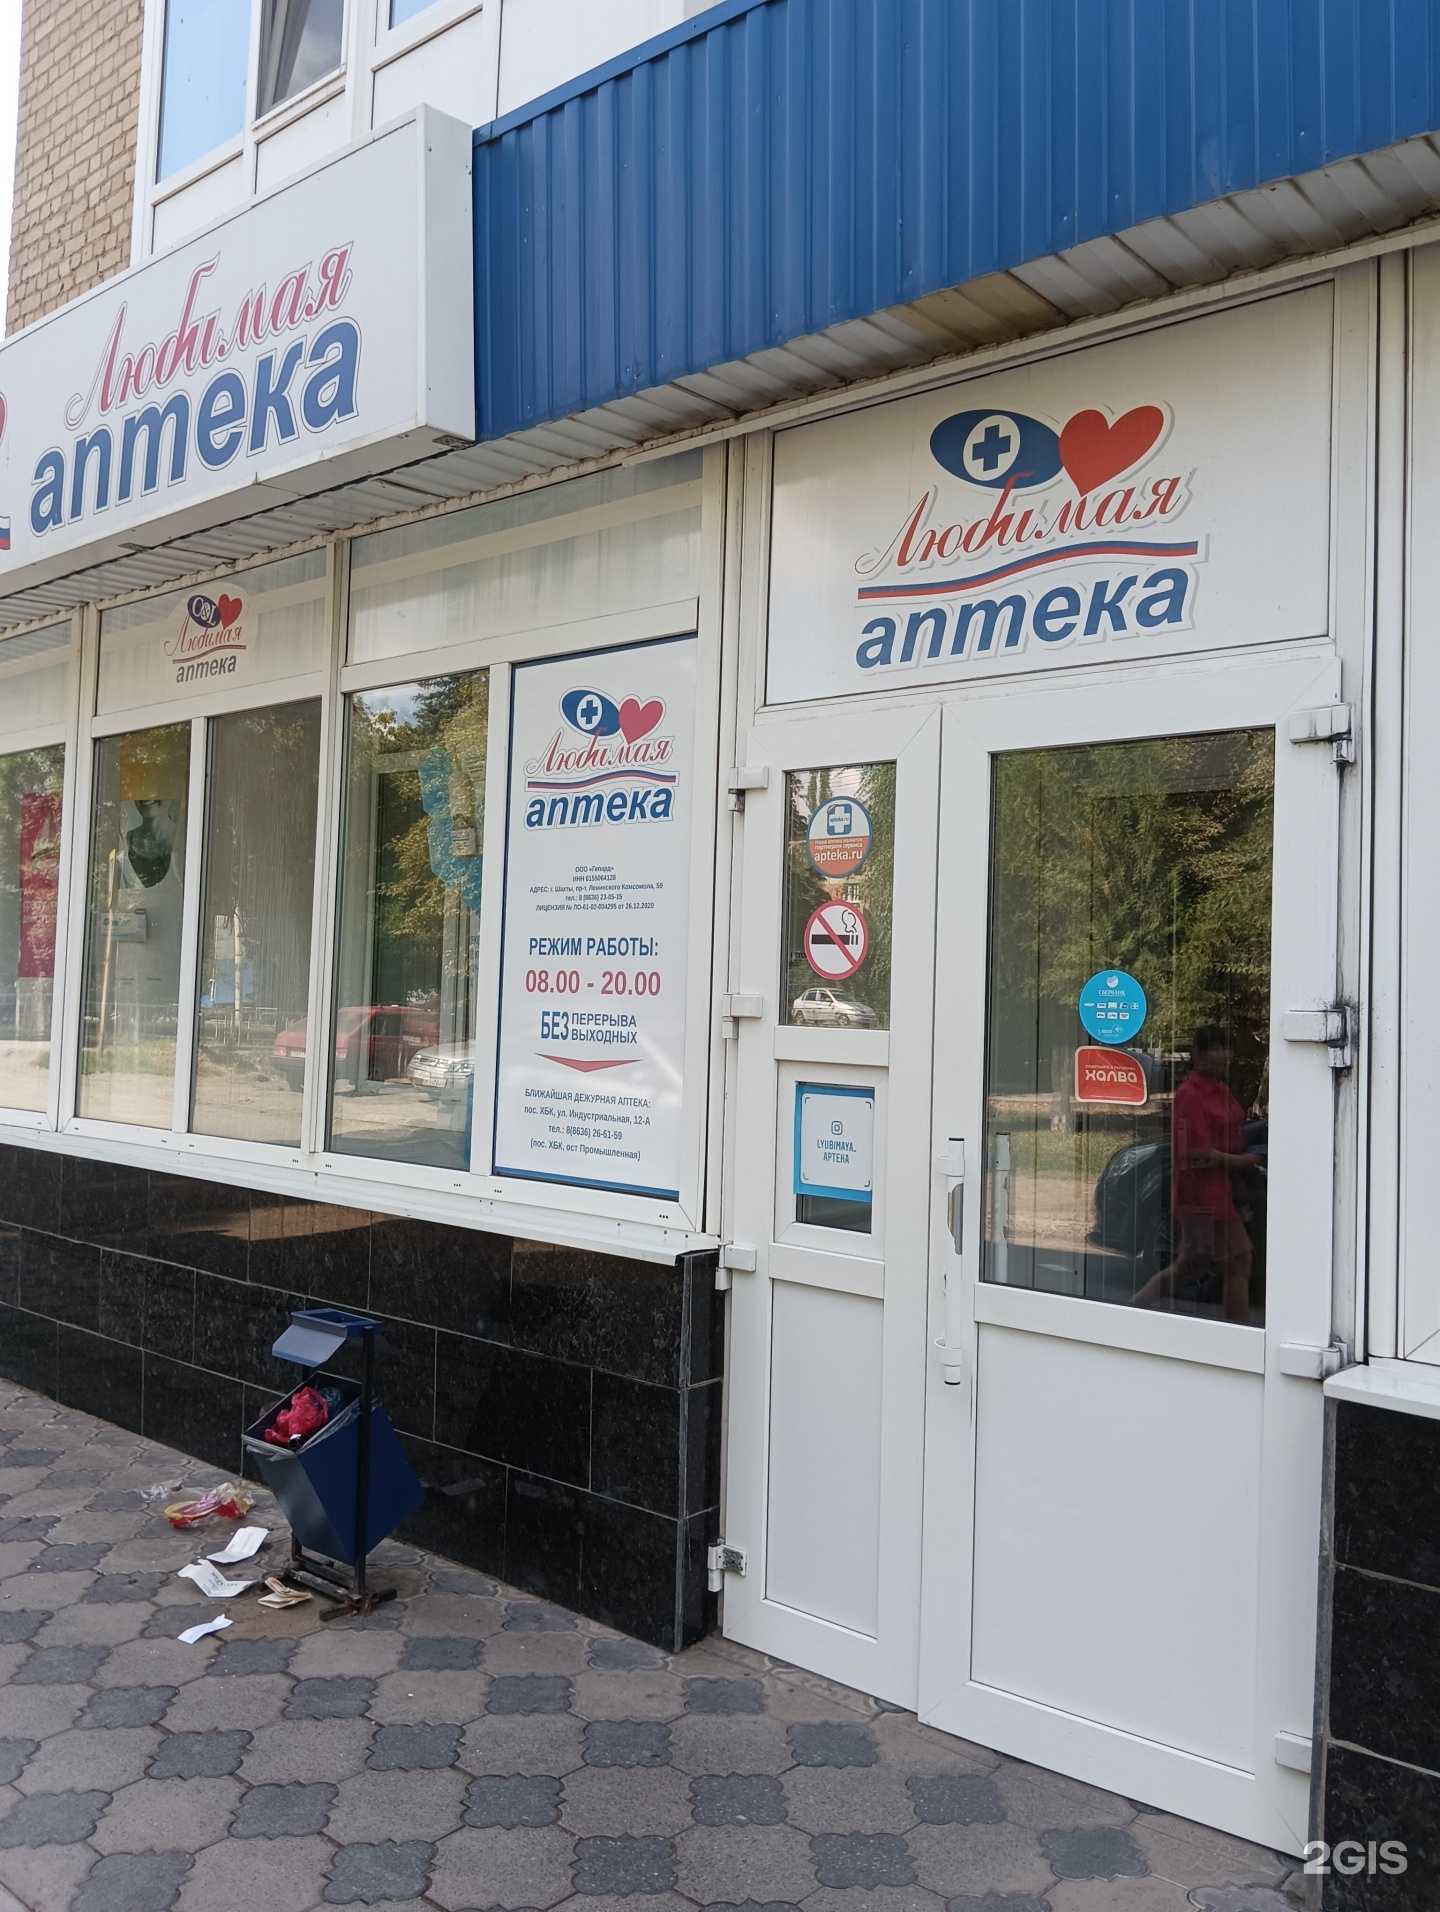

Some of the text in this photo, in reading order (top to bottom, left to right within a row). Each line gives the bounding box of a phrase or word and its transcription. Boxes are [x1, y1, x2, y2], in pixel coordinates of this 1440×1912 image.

[68, 246, 351, 425] Любимая
[31, 321, 357, 534] аптека
[854, 471, 1181, 575] Любимая
[856, 568, 1188, 669] аптека
[164, 614, 243, 656] Любимая
[176, 655, 237, 683] аптека
[526, 727, 670, 774] Любимая
[526, 788, 672, 827] аптека
[814, 849, 863, 864] apteka.ru
[529, 936, 659, 956] РЕЖИМ РАБОТЫ:
[525, 969, 580, 994] 08.00
[601, 971, 661, 996] 20.00
[541, 1011, 637, 1040] БЕЗ ПЕРЕРЫВА
[571, 1028, 638, 1045] ВЫХОДНЫХ
[525, 1088, 652, 1108] БЛИЖАЙШАЯ ДЕЖУРНАЯ АПТЕКА:
[524, 1105, 538, 1114] пос.
[540, 1106, 556, 1117] ХБК,
[557, 1108, 567, 1118] ул.
[569, 1110, 632, 1125] Индустриальная,
[548, 1124, 565, 1134] тел.:
[530, 1138, 641, 1161] (пос. ХБК, ост Промышленная)
